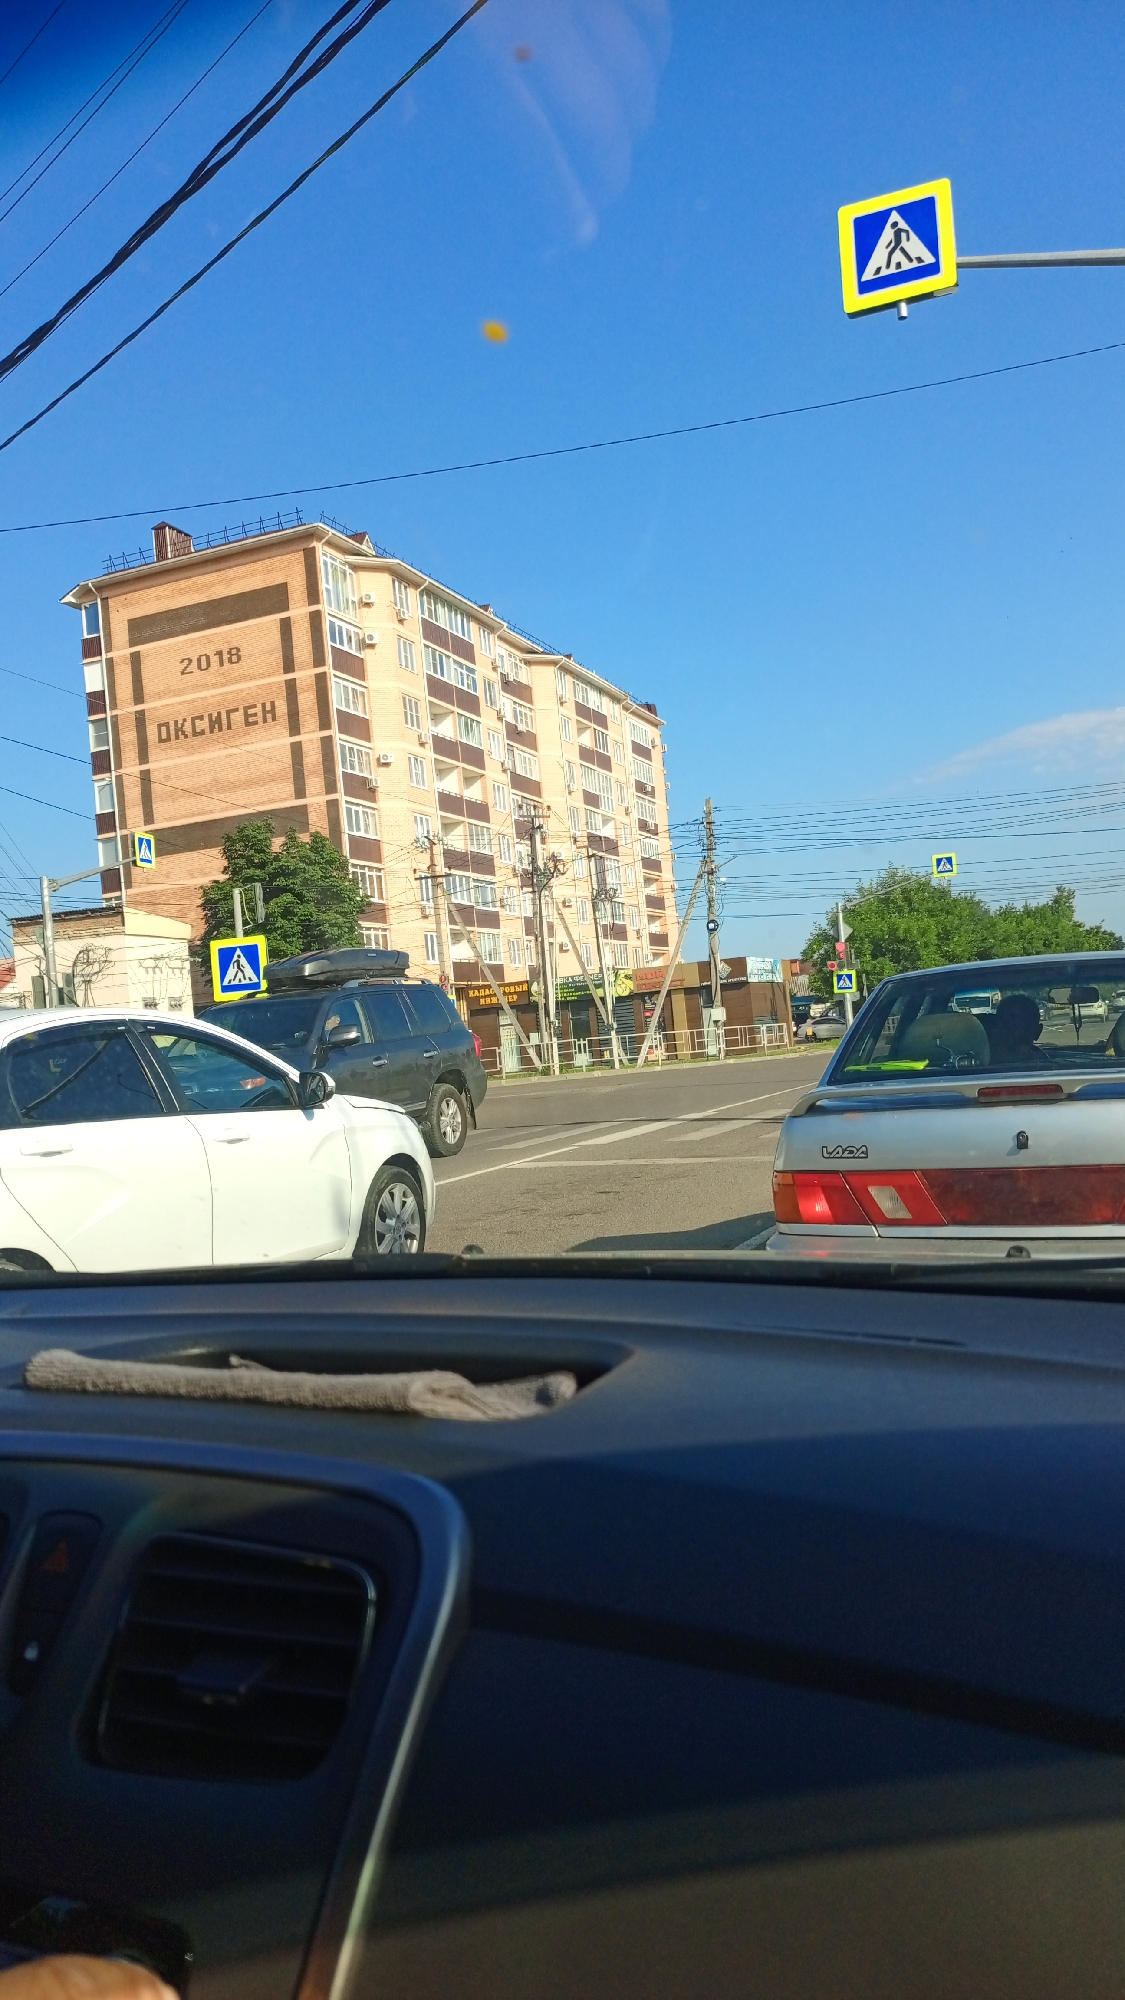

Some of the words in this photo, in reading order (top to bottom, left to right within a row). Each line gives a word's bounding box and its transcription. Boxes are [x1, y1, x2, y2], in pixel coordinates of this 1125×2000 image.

[179, 646, 242, 676] 2018
[156, 700, 277, 744] ОКСИГЕН
[468, 983, 528, 998] КАДАСРОВЫЙ
[480, 994, 518, 1005] ИНЖНЕР
[822, 1145, 868, 1159] LADA
